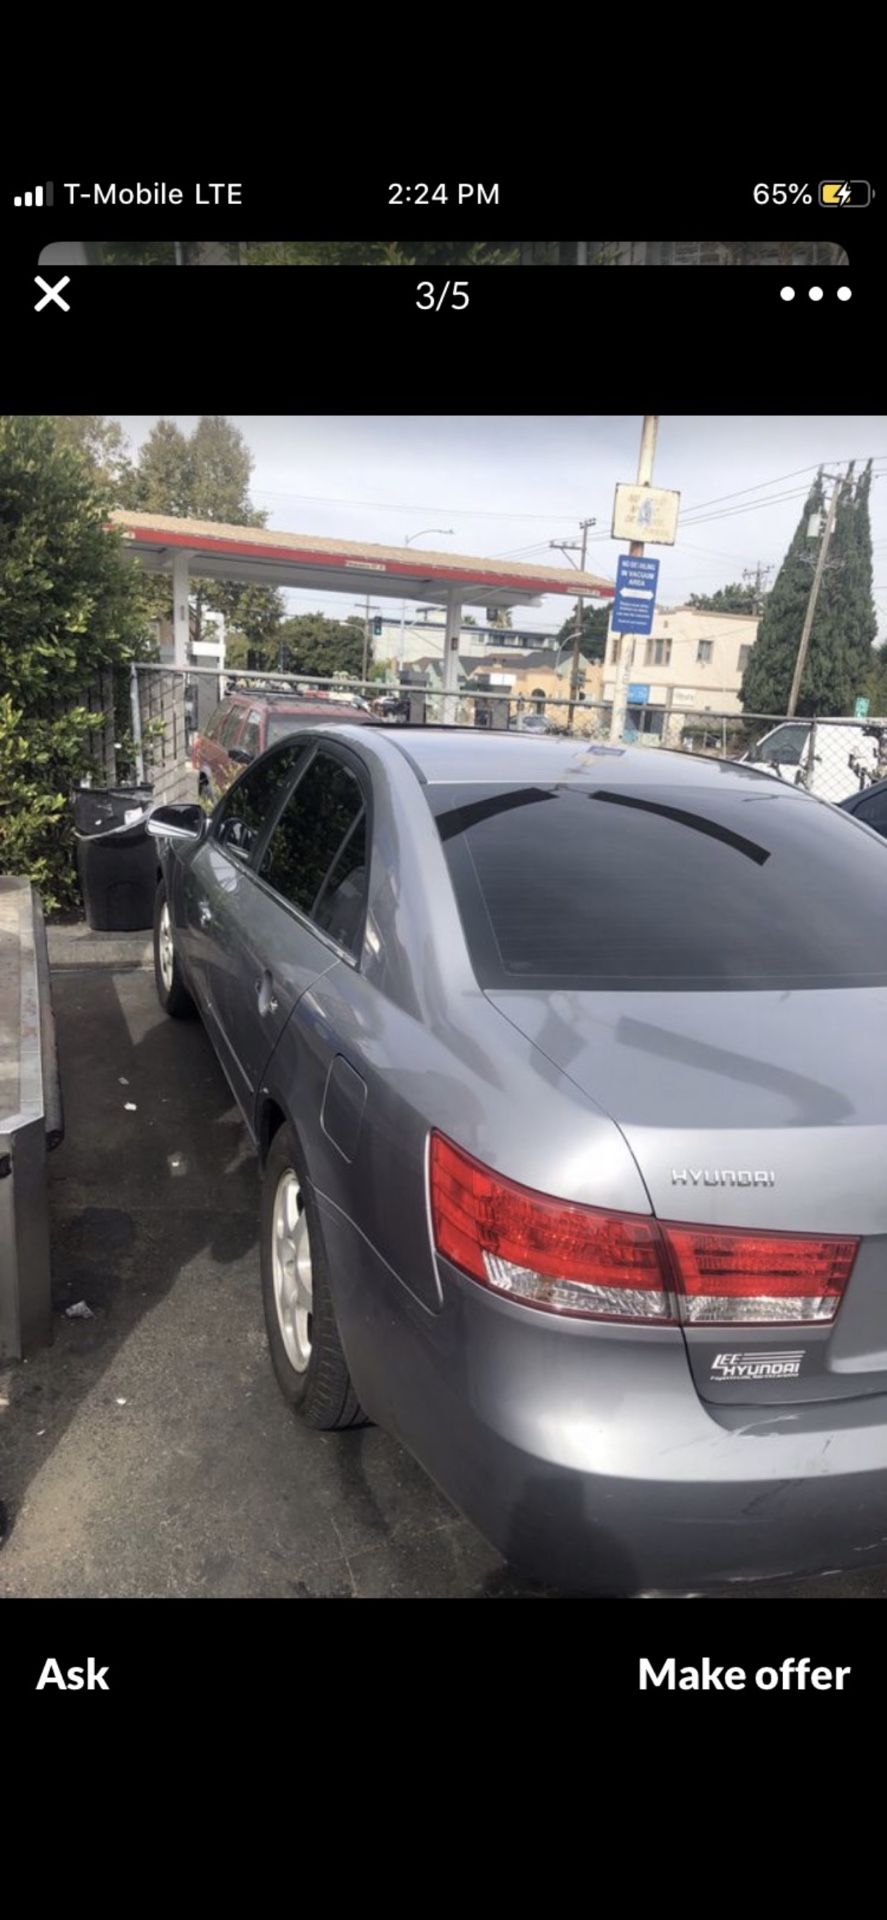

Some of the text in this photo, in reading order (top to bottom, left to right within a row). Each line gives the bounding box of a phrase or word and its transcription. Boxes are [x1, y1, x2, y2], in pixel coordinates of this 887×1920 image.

[671, 1168, 776, 1188] HYUNDAI
[711, 1353, 743, 1369] LEE
[722, 1362, 801, 1376] HYUNDAI
